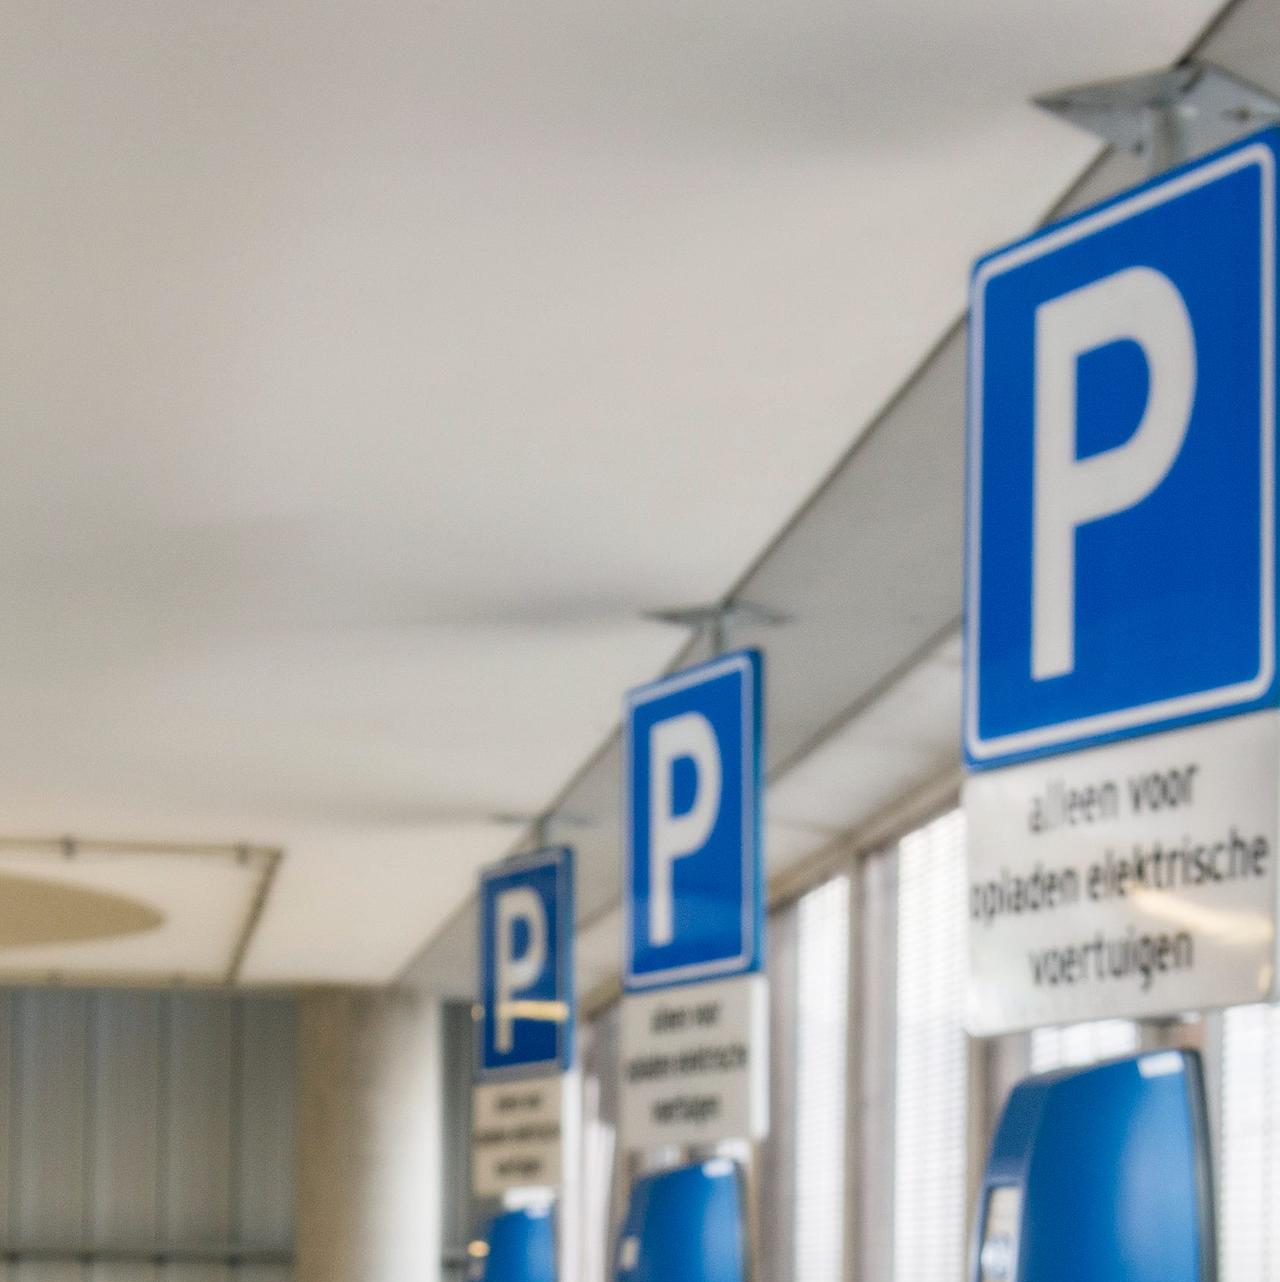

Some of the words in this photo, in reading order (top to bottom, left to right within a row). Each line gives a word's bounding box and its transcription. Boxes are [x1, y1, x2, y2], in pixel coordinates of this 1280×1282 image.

[1031, 266, 1197, 682] P
[648, 711, 722, 947] P
[1028, 775, 1119, 834] alleen
[1126, 762, 1199, 813] voor
[1087, 826, 1269, 901] elektrische
[1028, 924, 1195, 991] voertuigen
